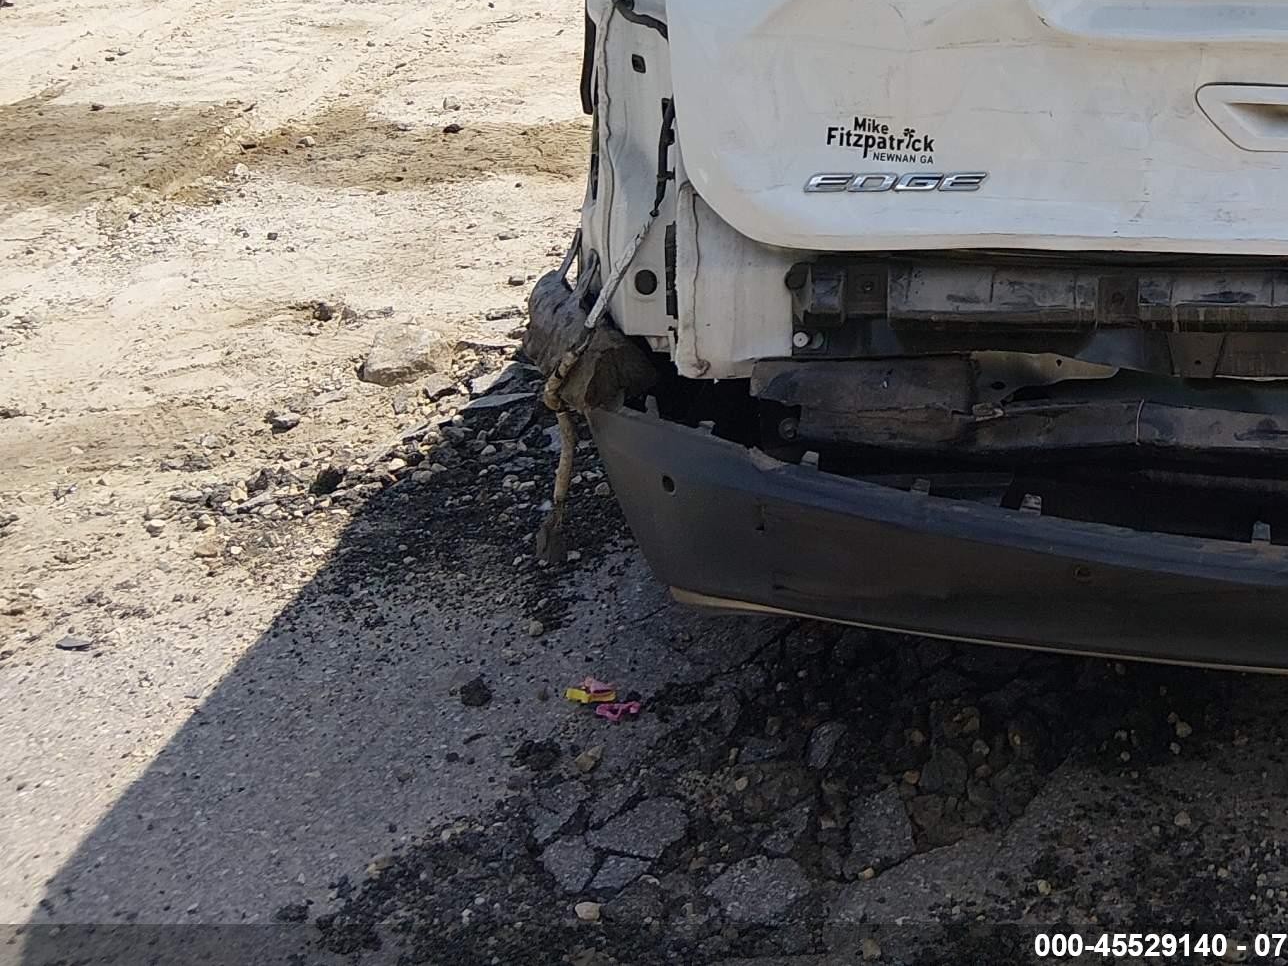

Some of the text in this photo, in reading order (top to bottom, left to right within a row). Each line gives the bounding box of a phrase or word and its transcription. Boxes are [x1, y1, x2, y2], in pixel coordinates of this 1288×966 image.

[853, 116, 890, 135] Mike
[826, 126, 935, 159] Fitzpatrick
[872, 152, 934, 165] NEWNAN GA
[803, 171, 988, 193] EDGE
